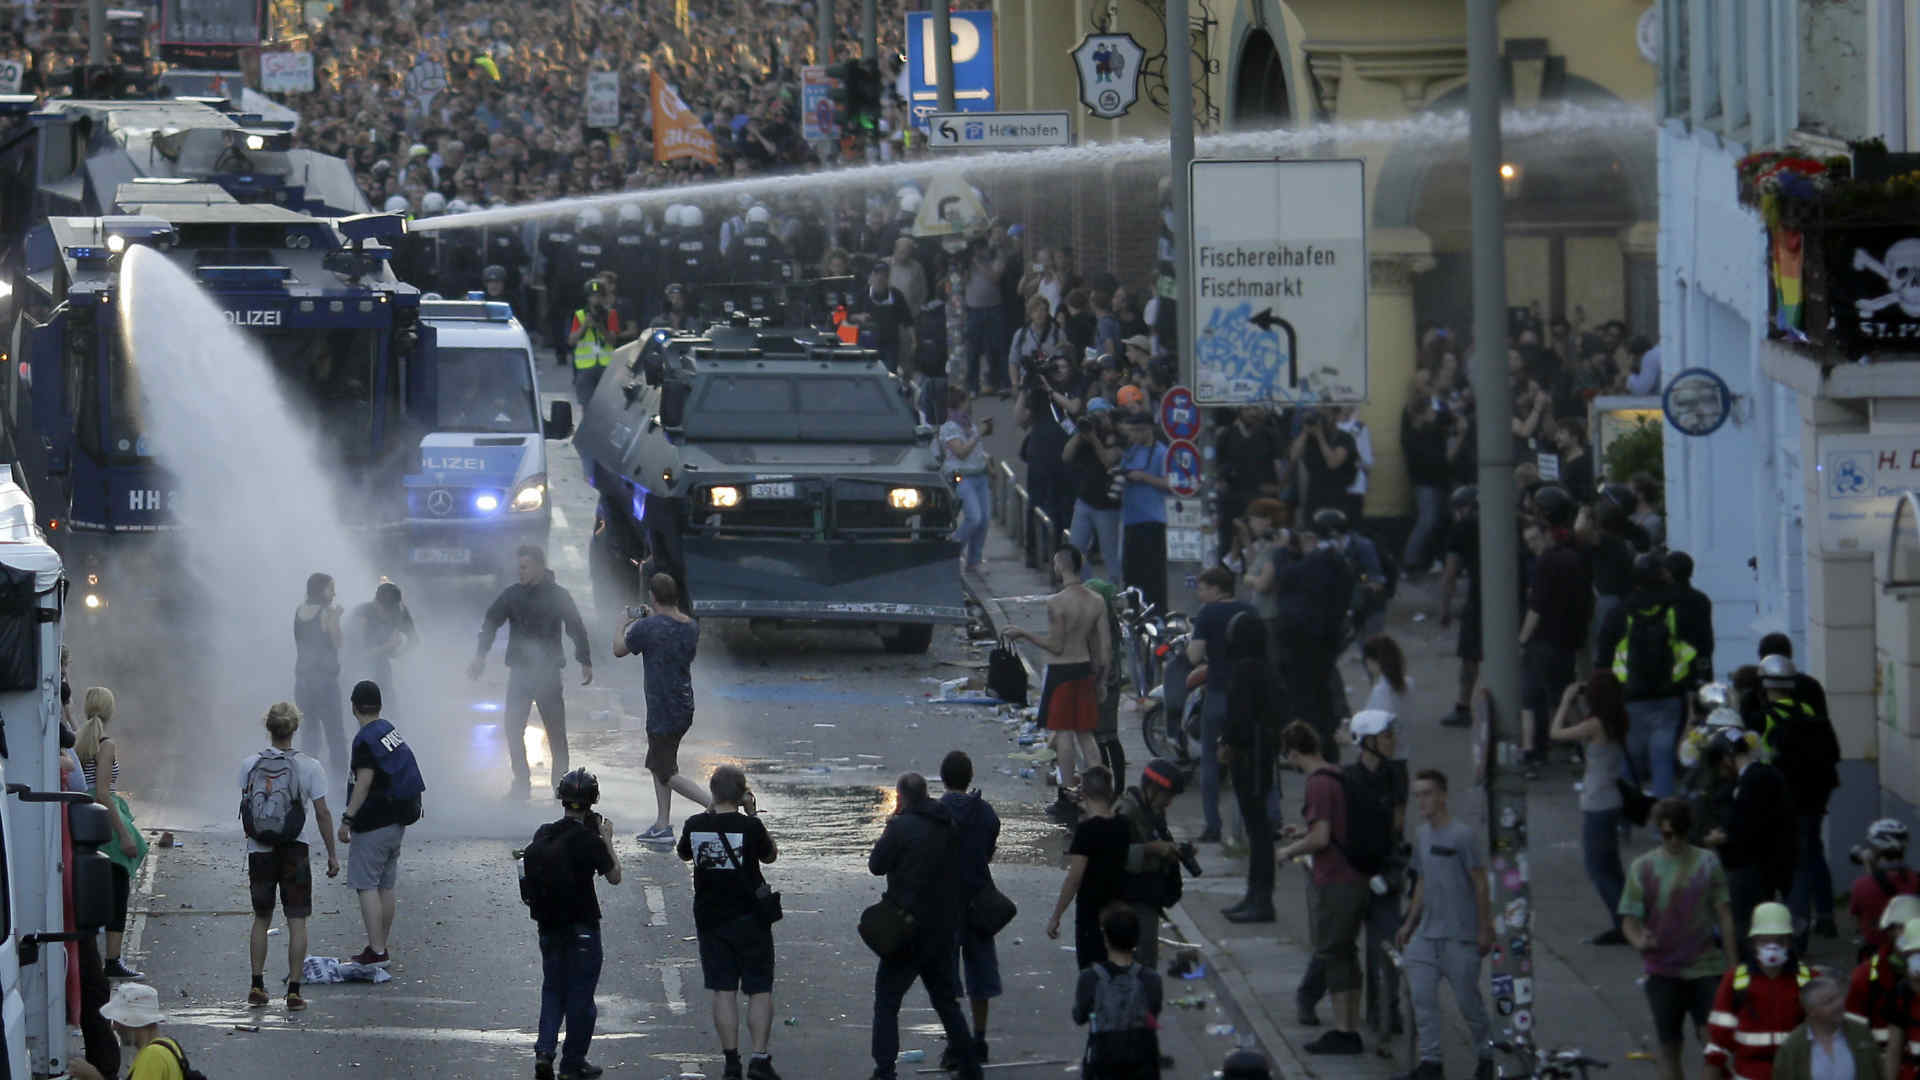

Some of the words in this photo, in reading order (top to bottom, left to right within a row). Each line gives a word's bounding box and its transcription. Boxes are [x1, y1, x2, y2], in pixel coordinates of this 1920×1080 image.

[1200, 246, 1336, 268] Fischereihafen
[1200, 276, 1303, 297] Fischmarkt
[222, 310, 282, 326] OLIZEI
[422, 456, 486, 471] LIZEI
[1878, 449, 1900, 471] H.
[129, 489, 160, 511] HH
[380, 728, 404, 752] PRE
